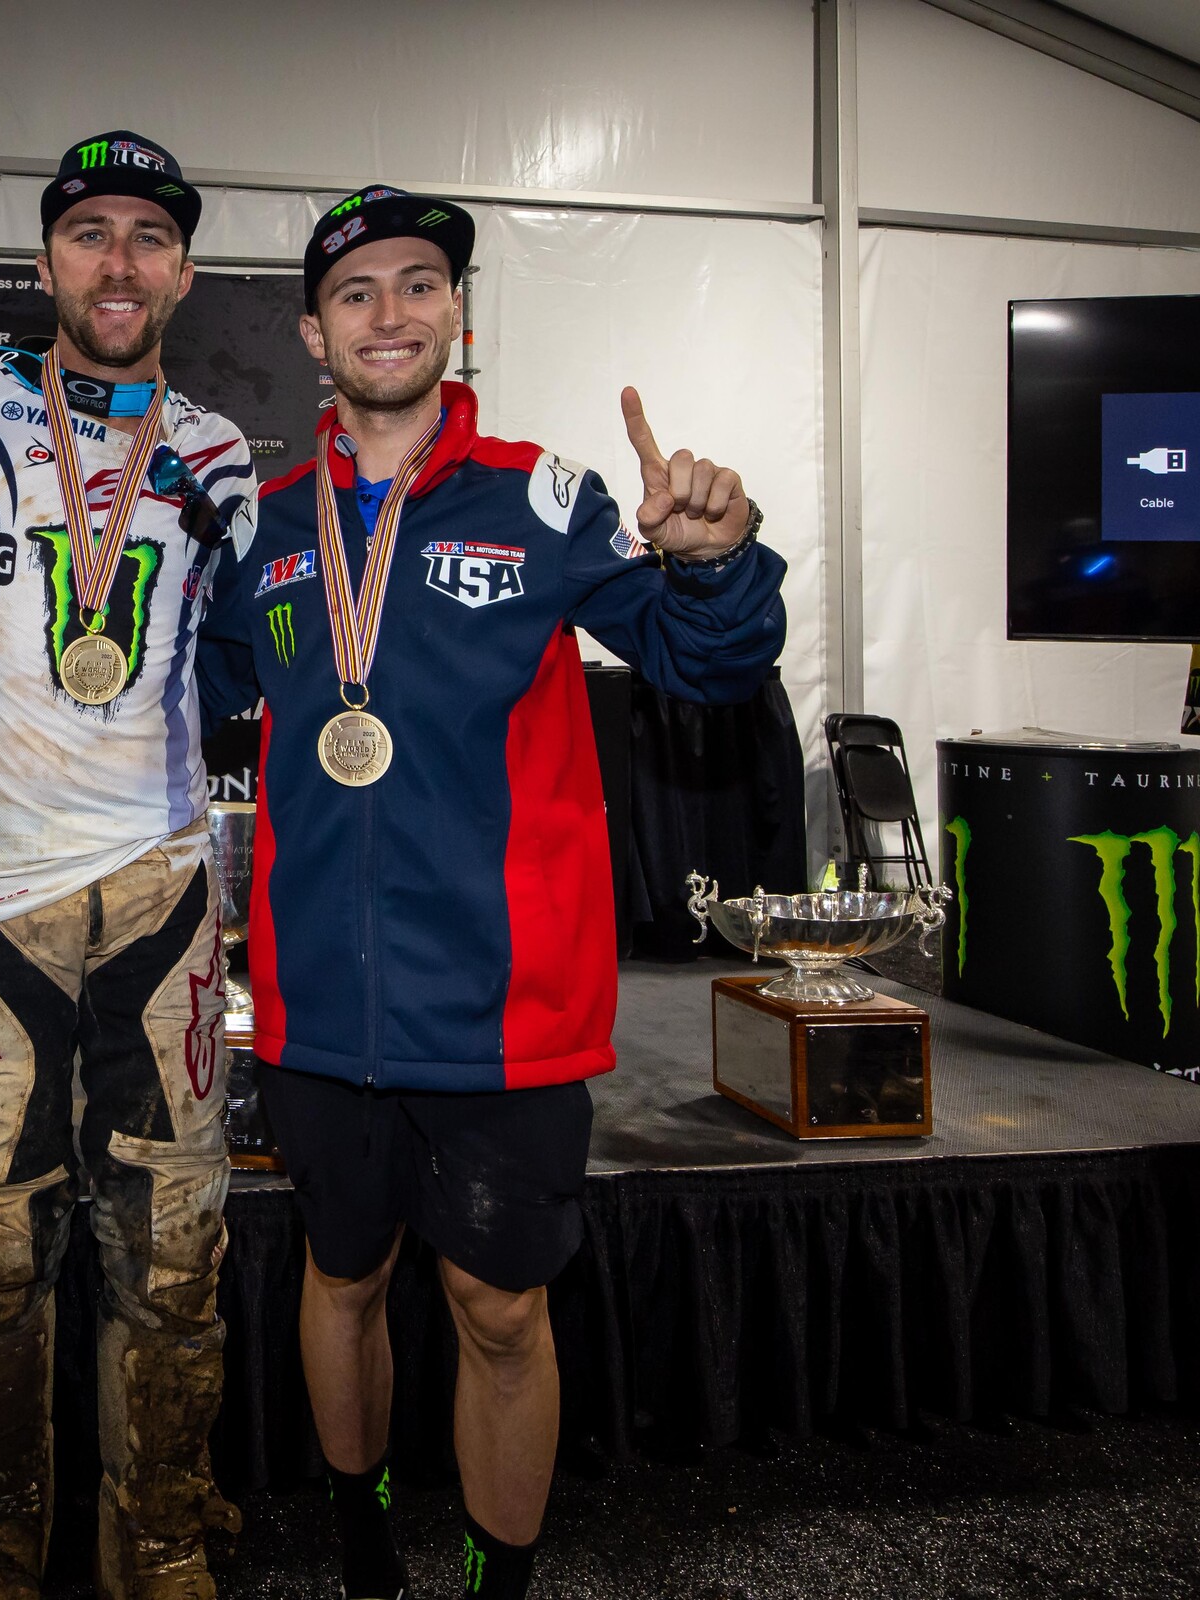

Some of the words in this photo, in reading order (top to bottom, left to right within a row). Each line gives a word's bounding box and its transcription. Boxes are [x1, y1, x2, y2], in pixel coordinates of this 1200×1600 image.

[322, 215, 367, 255] 32
[16, 280, 31, 289] OF
[1140, 498, 1175, 508] Cable
[421, 541, 464, 554] AMA
[476, 546, 509, 556] MOTOCROSS
[510, 550, 525, 558] TEAM
[255, 549, 316, 596] AMA
[426, 555, 524, 608] USA
